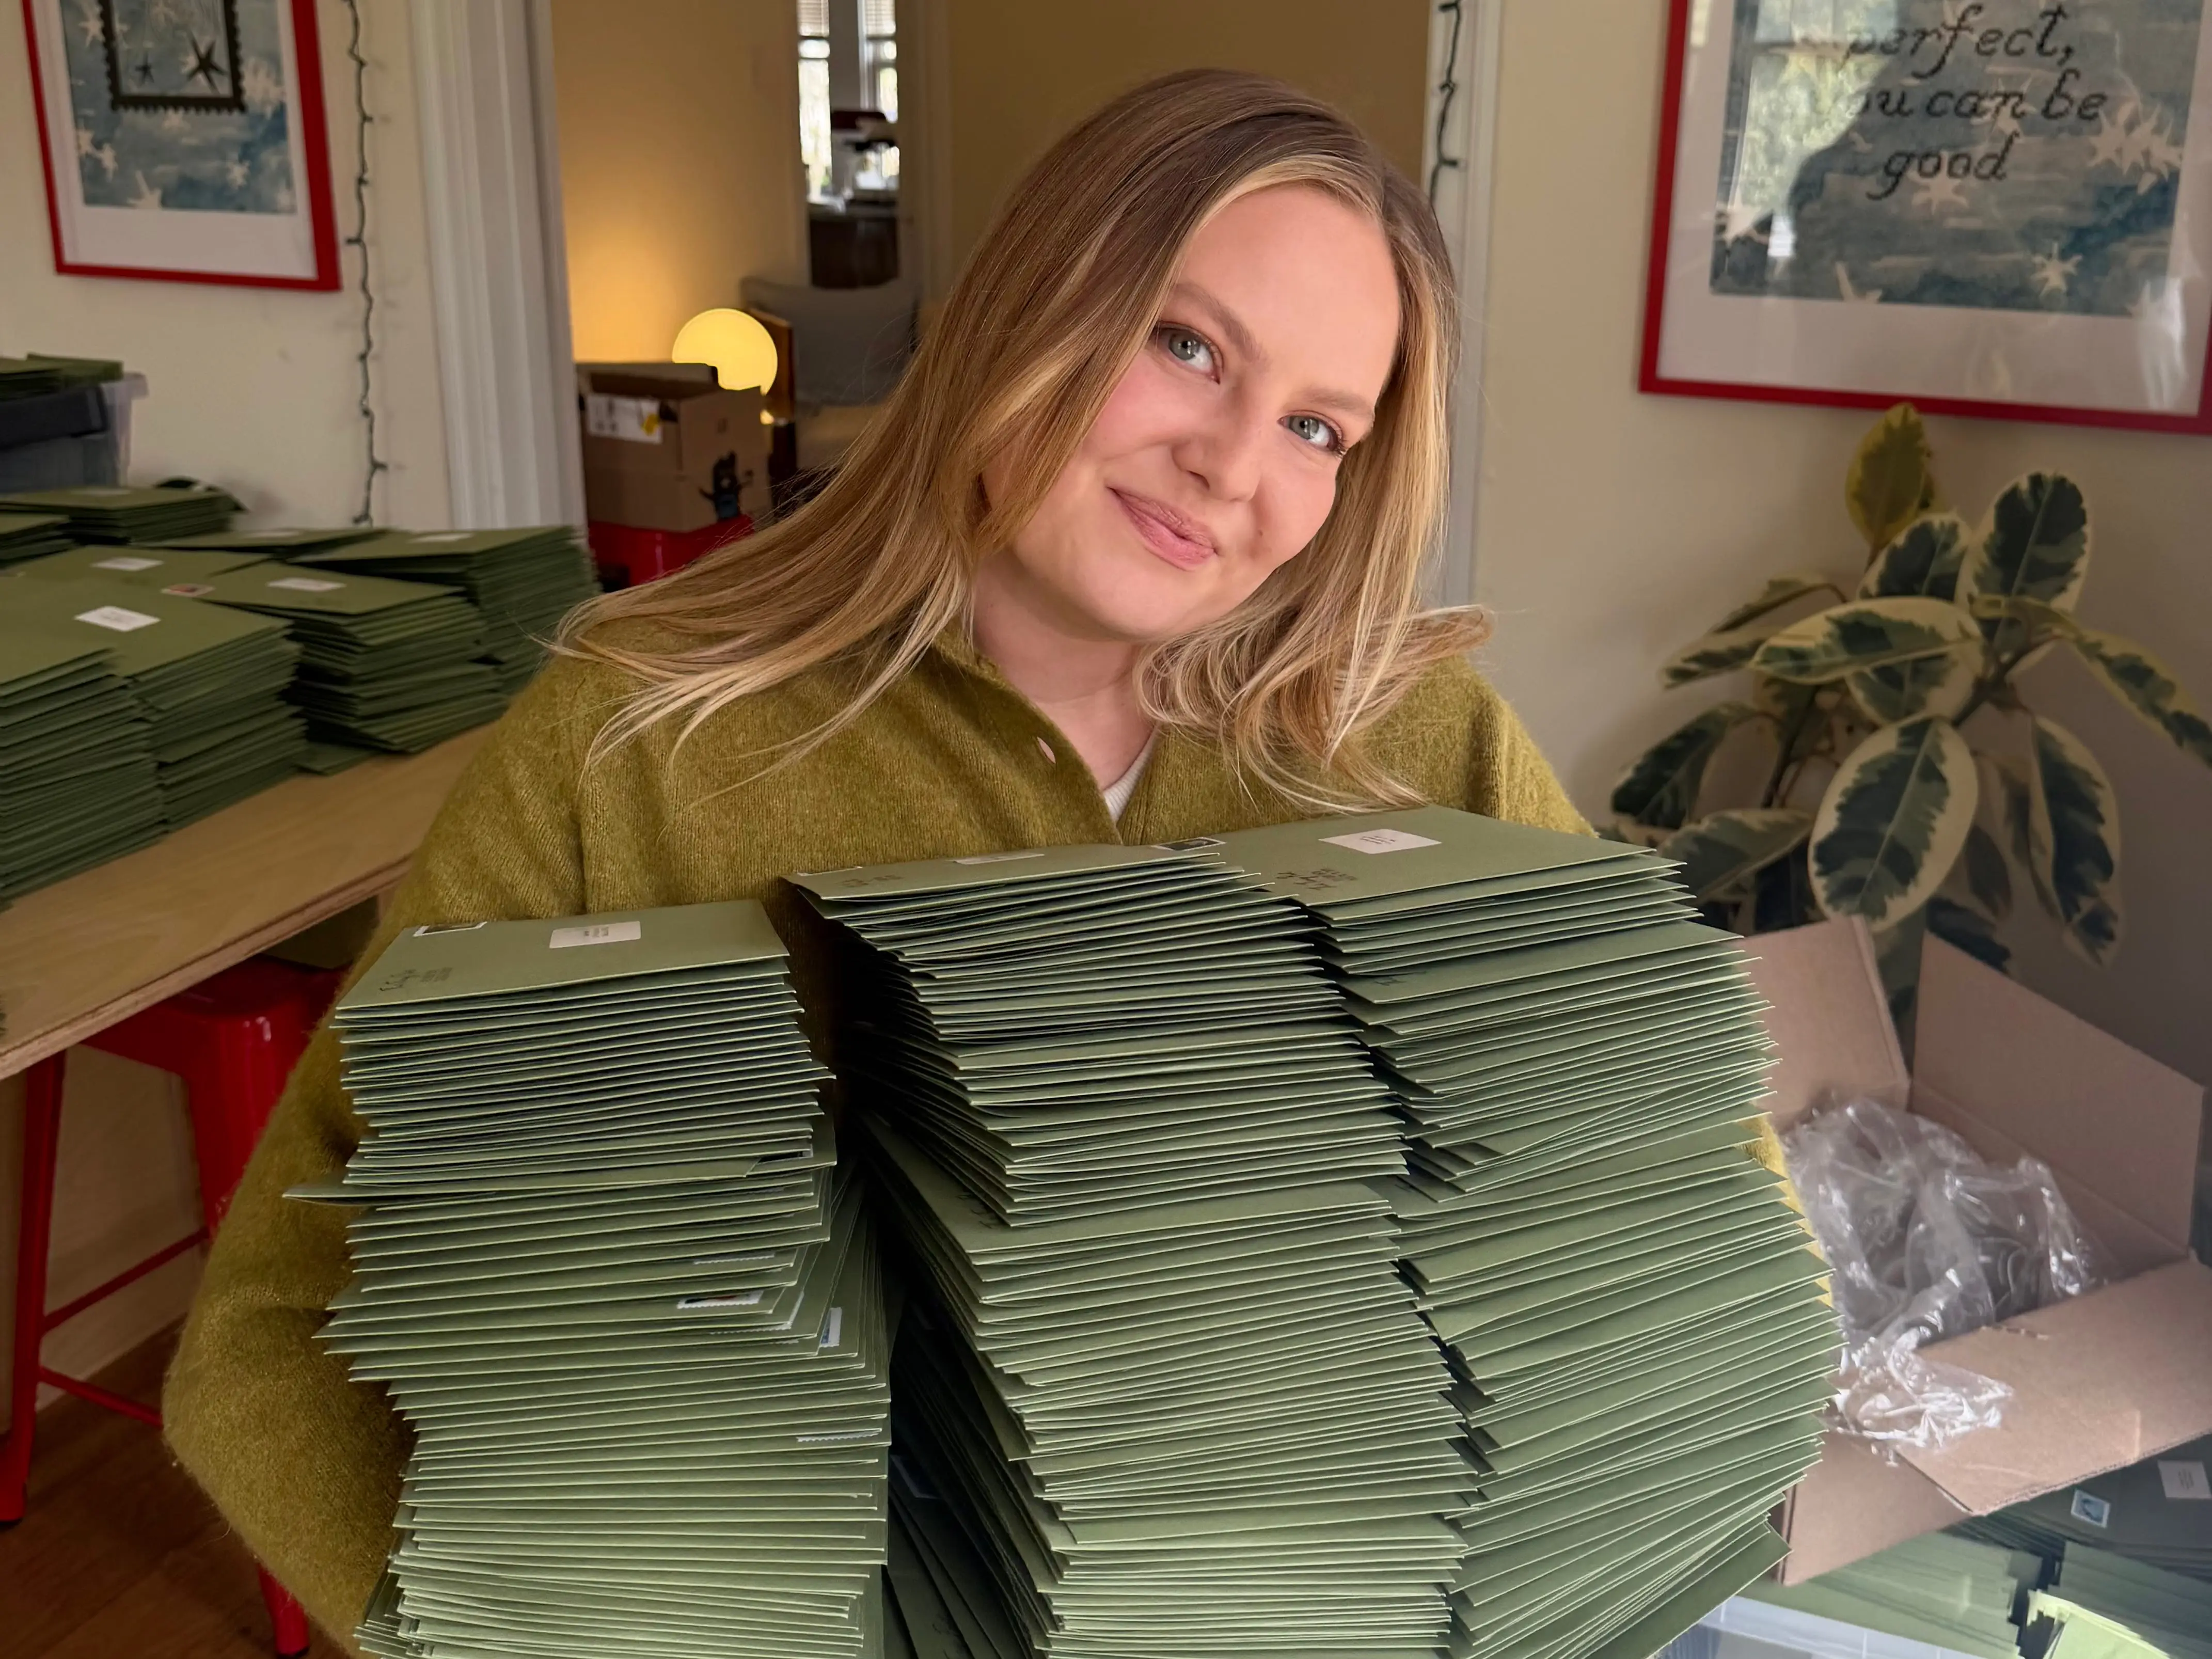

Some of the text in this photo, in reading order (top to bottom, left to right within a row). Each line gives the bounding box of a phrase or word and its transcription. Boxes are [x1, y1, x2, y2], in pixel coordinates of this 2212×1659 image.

[1925, 90, 2026, 119] can
[2042, 68, 2109, 121] be
[1866, 131, 2020, 201] good
